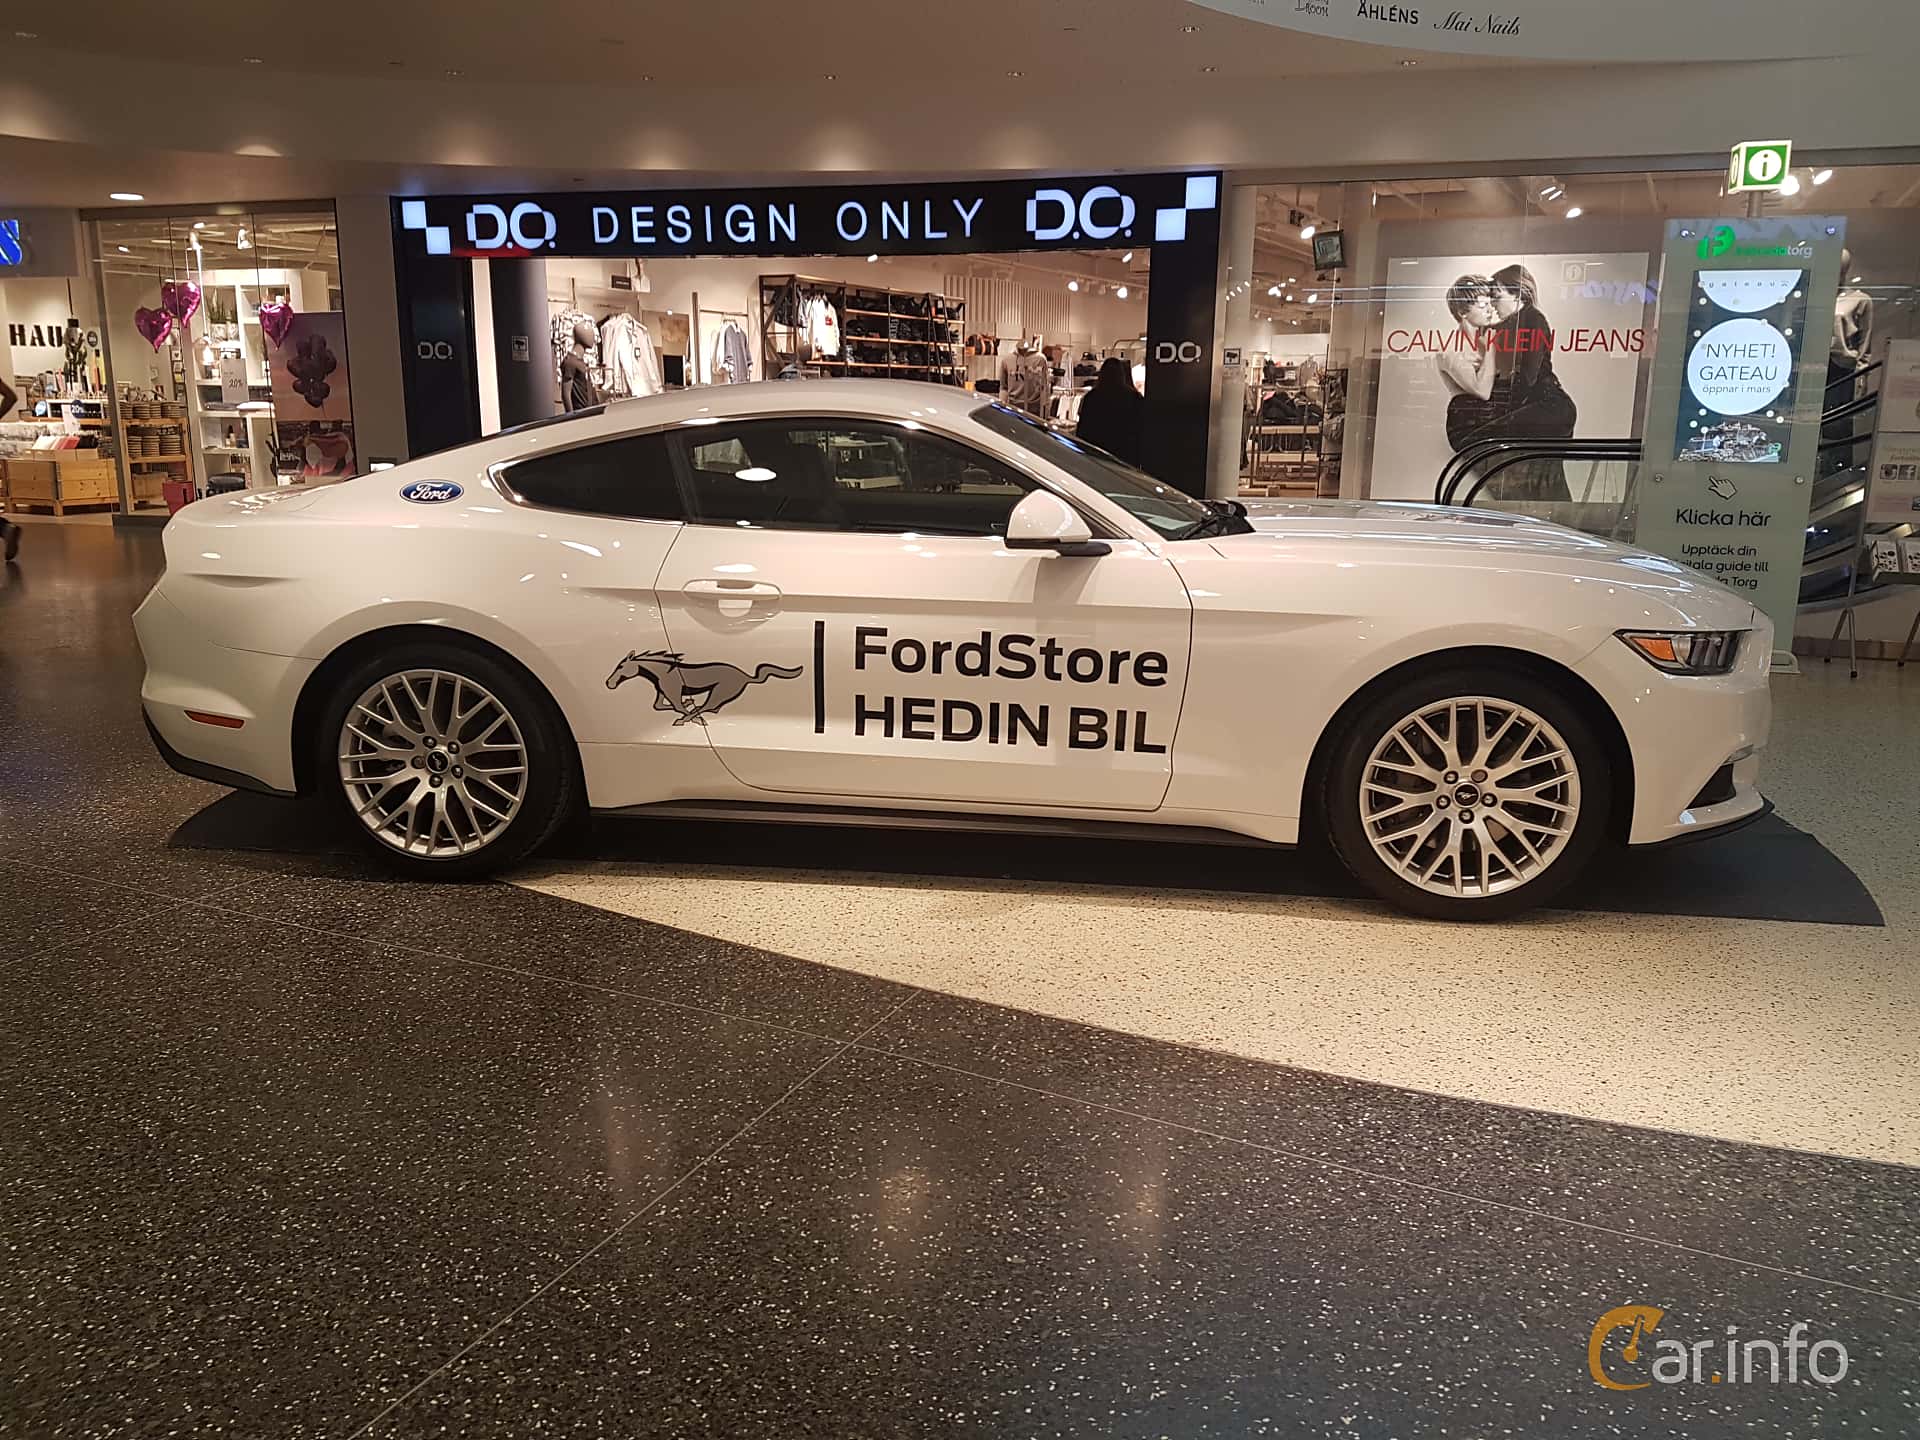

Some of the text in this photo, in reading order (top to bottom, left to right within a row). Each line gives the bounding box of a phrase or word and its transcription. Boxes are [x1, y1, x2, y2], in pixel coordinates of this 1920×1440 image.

[1357, 0, 1419, 24] ÅHLÉNS
[1433, 10, 1520, 36] Mai Nails
[465, 185, 1136, 250] D.O. DESIGN ONLY D.O.
[1387, 328, 1645, 352] CALVIN KLEIN JEANS
[1706, 343, 1776, 358] NYHET!
[1699, 365, 1778, 381] GATEAU
[1702, 384, 1738, 396] öppnar
[1747, 385, 1771, 393] mars
[410, 483, 453, 500] Ford
[1676, 508, 1771, 527] Klicka här
[1681, 543, 1757, 557] Upptäck din
[1716, 561, 1751, 574] guide
[1754, 561, 1769, 572] till
[1730, 576, 1758, 590] Torg
[855, 625, 1168, 687] FordStore
[855, 694, 1167, 754] HEDIN BIL
